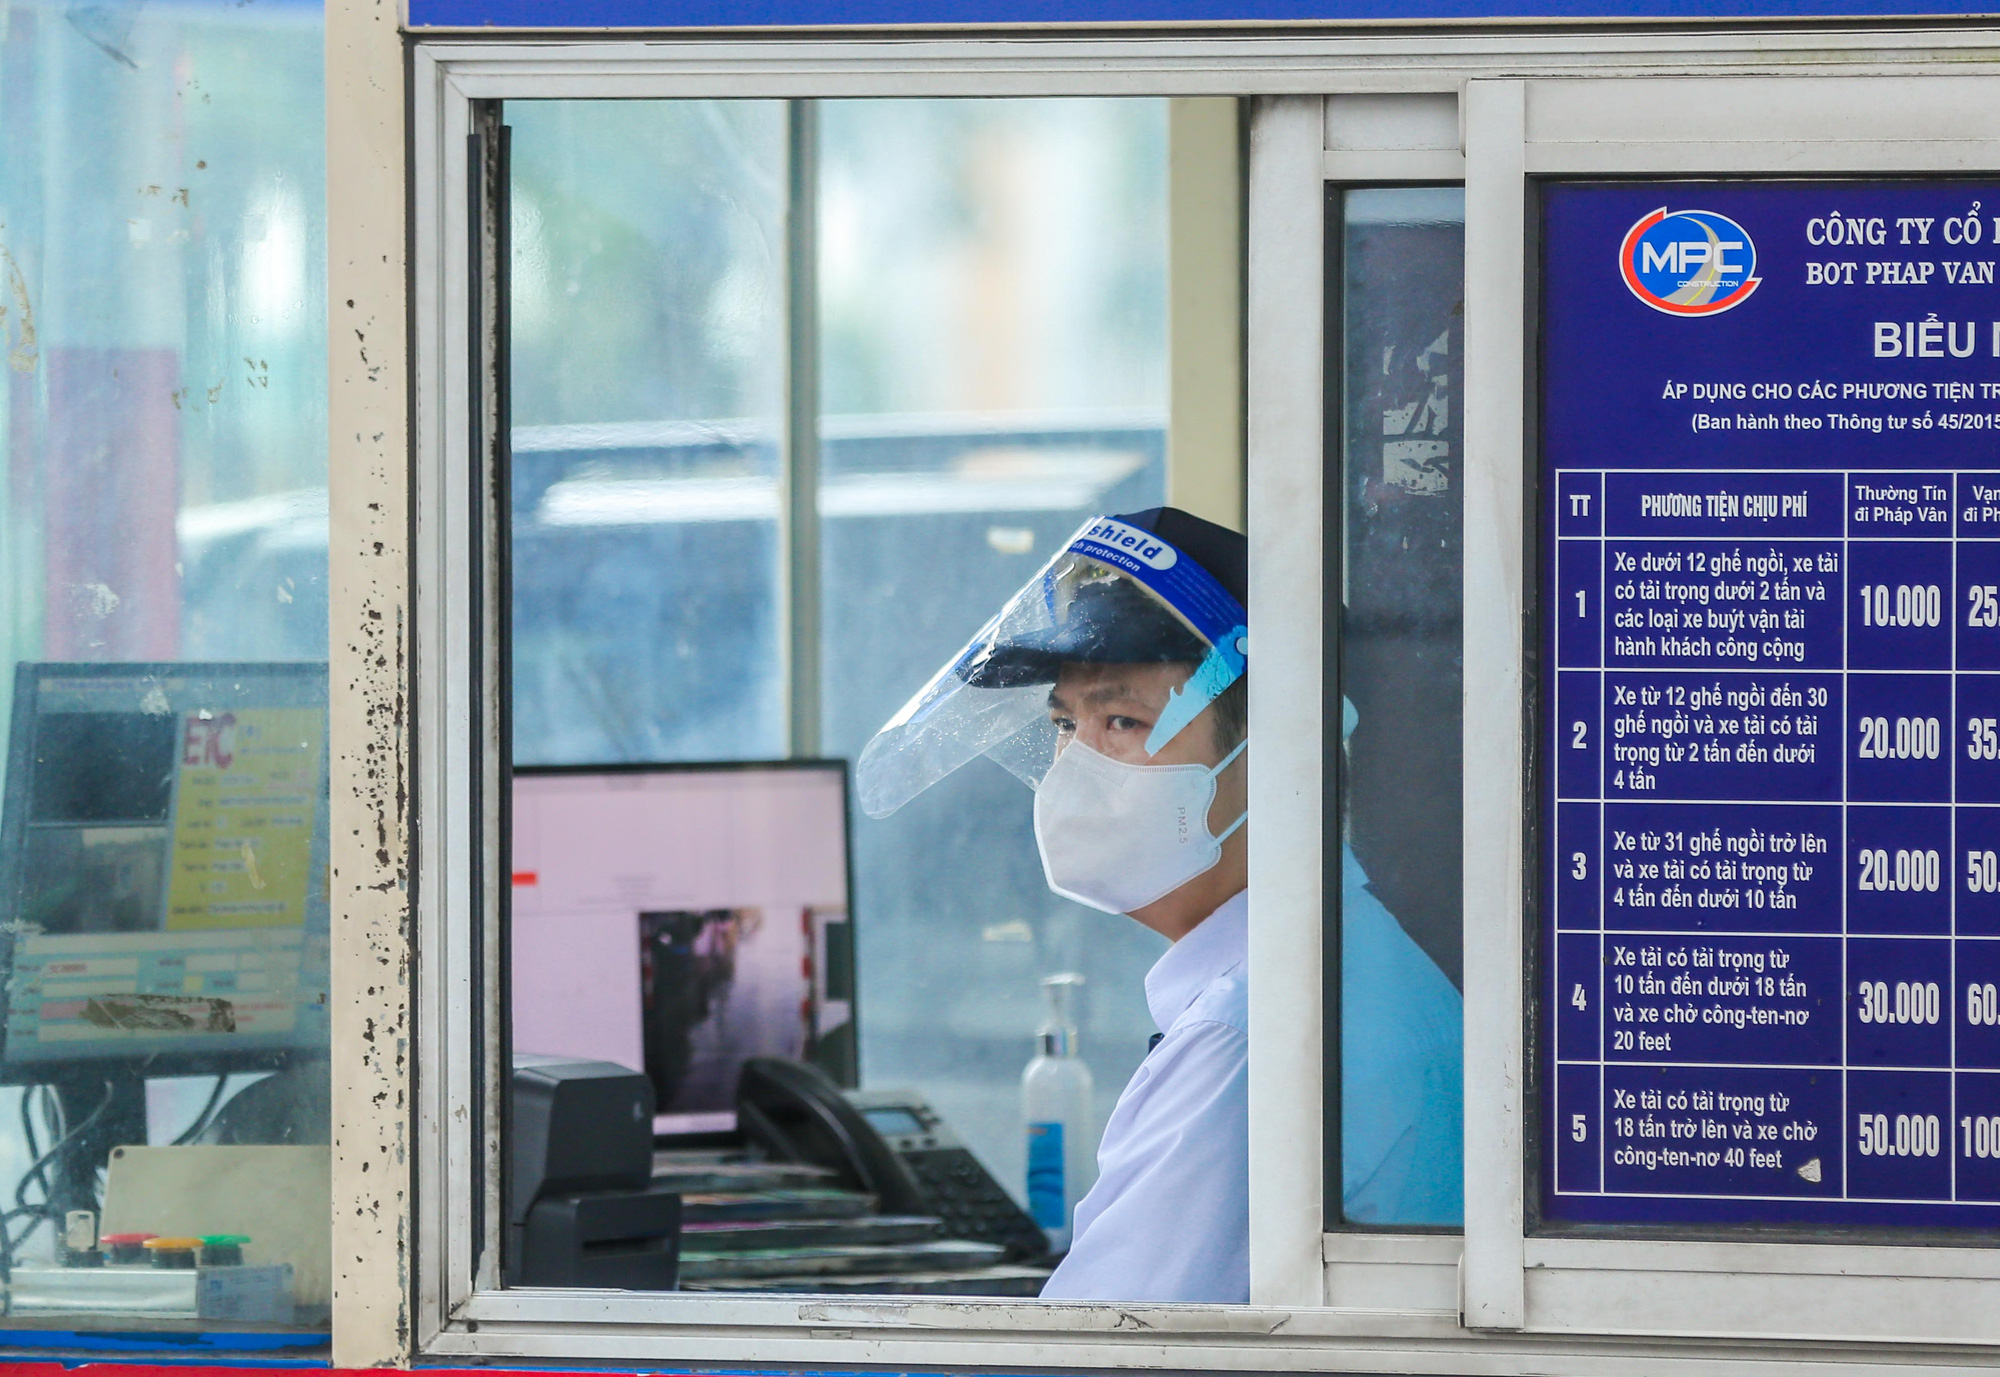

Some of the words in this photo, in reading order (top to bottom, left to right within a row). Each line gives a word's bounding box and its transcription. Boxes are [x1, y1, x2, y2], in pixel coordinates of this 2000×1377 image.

[1806, 210, 1888, 246] CÔNG
[1895, 217, 1935, 245] TY
[1943, 200, 1982, 245] CỔ
[1642, 241, 1743, 274] MPC
[1677, 280, 1739, 288] CONSTRUCTION
[1805, 261, 1858, 285] BOT
[1865, 261, 1935, 285] PHAP
[1941, 261, 1996, 284] VAN
[1874, 312, 1976, 358] BIỂU
[1661, 379, 1688, 400] ÁP
[1693, 383, 1747, 404] DỤNG
[1751, 383, 1793, 400] CHO
[1797, 379, 1838, 400] CÁC
[1842, 382, 1927, 400] PHƯƠNG
[1931, 381, 1975, 403] TIỆN
[1691, 413, 1731, 434] (Ban
[1736, 413, 1779, 430] hành
[1783, 413, 1823, 430] theo
[1826, 413, 1883, 434] Thông
[1887, 414, 1908, 430] tư
[1911, 410, 1934, 430] số
[1569, 494, 1592, 517] TT
[1641, 492, 1702, 517] PHƯƠNG
[1705, 489, 1739, 522] TIỆN
[1742, 494, 1778, 522] CHỊU
[1781, 490, 1808, 518] PHÍ
[1854, 484, 1918, 505] Thường
[1921, 485, 1947, 501] Tín
[1854, 506, 1869, 522] đi
[1873, 506, 1914, 526] Pháp
[1916, 506, 1947, 522] Vân
[1963, 506, 1978, 522] đi
[1088, 525, 1163, 560] shield
[1084, 544, 1141, 572] protection
[1614, 551, 1637, 572] Xe
[1640, 551, 1682, 572] dưới
[1686, 552, 1706, 572] 12
[1710, 547, 1742, 577] ghế
[1746, 547, 1788, 578] ngồi,
[1792, 557, 1813, 573] xe
[1817, 551, 1838, 573] tải
[1575, 590, 1586, 618] 1
[1614, 579, 1636, 600] có
[1639, 579, 1660, 600] tải
[1664, 581, 1710, 606] trọng
[1714, 580, 1755, 601] dưới
[1759, 580, 1770, 601] 2
[1773, 576, 1801, 601] tấn
[1804, 580, 1826, 601] và
[1614, 607, 1644, 628] các
[1648, 607, 1679, 633] loại
[1682, 612, 1703, 629] xe
[1707, 608, 1745, 634] buýt
[1748, 608, 1780, 634] vận
[1783, 608, 1805, 629] tải
[1860, 584, 1941, 628] 10.000
[1614, 635, 1656, 656] hành
[1660, 636, 1711, 657] khách
[1715, 636, 1758, 662] công
[1762, 636, 1805, 663] cộng
[1613, 685, 1637, 706] Xe
[1640, 685, 1662, 706] từ
[1665, 686, 1686, 706] 12
[1689, 681, 1723, 711] ghế
[1727, 682, 1765, 712] ngồi
[1770, 682, 1803, 707] đến
[1807, 687, 1828, 707] 30
[1572, 720, 1587, 749] 2
[1614, 709, 1647, 739] ghế
[1651, 710, 1689, 739] ngồi
[1693, 719, 1715, 735] và
[1718, 719, 1740, 735] xe
[1743, 714, 1765, 735] tải
[1769, 714, 1792, 735] có
[1795, 714, 1818, 736] tải
[1859, 716, 1940, 760] 20.000
[1613, 742, 1660, 767] trọng
[1664, 741, 1685, 762] từ
[1688, 742, 1699, 762] 2
[1703, 738, 1731, 763] tấn
[1735, 738, 1768, 763] đến
[1772, 743, 1815, 764] dưới
[1613, 769, 1625, 790] 4
[1628, 765, 1656, 790] tấn
[1613, 830, 1637, 851] Xe
[1640, 830, 1661, 851] từ
[1664, 831, 1683, 852] 31
[1689, 827, 1722, 857] ghế
[1726, 827, 1765, 858] ngồi
[1769, 832, 1797, 853] trở
[1800, 833, 1827, 854] lên
[1571, 851, 1587, 881] 3
[1613, 858, 1634, 879] và
[1638, 864, 1659, 879] xe
[1663, 858, 1685, 880] tải
[1689, 859, 1711, 880] có
[1714, 859, 1737, 880] tải
[1741, 861, 1788, 887] trọng
[1792, 860, 1814, 882] từ
[1858, 848, 1940, 892] 20.000
[1613, 887, 1625, 907] 4
[1628, 882, 1656, 907] tấn
[1660, 883, 1693, 908] đến
[1697, 888, 1740, 909] dưới
[1745, 888, 1765, 909] 10
[1768, 882, 1797, 909] tấn
[1613, 946, 1636, 967] Xe
[1640, 945, 1662, 967] tải
[1666, 946, 1688, 967] có
[1691, 946, 1714, 968] tải
[1717, 949, 1765, 974] trọng
[1768, 948, 1790, 969] từ
[1571, 983, 1587, 1012] 4
[1614, 974, 1634, 994] 10
[1638, 970, 1666, 995] tấn
[1670, 971, 1703, 996] đến
[1707, 975, 1750, 997] dưới
[1755, 976, 1775, 997] 18
[1779, 972, 1807, 998] tấn
[1613, 1002, 1634, 1023] và
[1638, 1007, 1659, 1023] xe
[1663, 1002, 1699, 1024] chở
[1702, 1003, 1810, 1030] công-ten-nơ
[1858, 981, 1940, 1025] 30.000
[1613, 1030, 1634, 1051] 20
[1638, 1030, 1672, 1052] feet
[1613, 1088, 1636, 1110] Xe
[1640, 1088, 1662, 1110] tải
[1666, 1090, 1688, 1111] có
[1692, 1090, 1714, 1111] tải
[1717, 1092, 1765, 1117] trọng
[1769, 1091, 1790, 1113] từ
[1572, 1113, 1587, 1143] 5
[1614, 1117, 1634, 1137] 18
[1638, 1113, 1666, 1138] tấn
[1670, 1117, 1698, 1139] trở
[1701, 1118, 1728, 1139] lên
[1731, 1119, 1753, 1140] và
[1757, 1124, 1778, 1141] xe
[1782, 1120, 1818, 1141] chở
[1858, 1113, 1940, 1158] 50.000
[1613, 1147, 1721, 1171] công-ten-nơ
[1723, 1147, 1745, 1168] 40
[1748, 1147, 1783, 1169] feet
